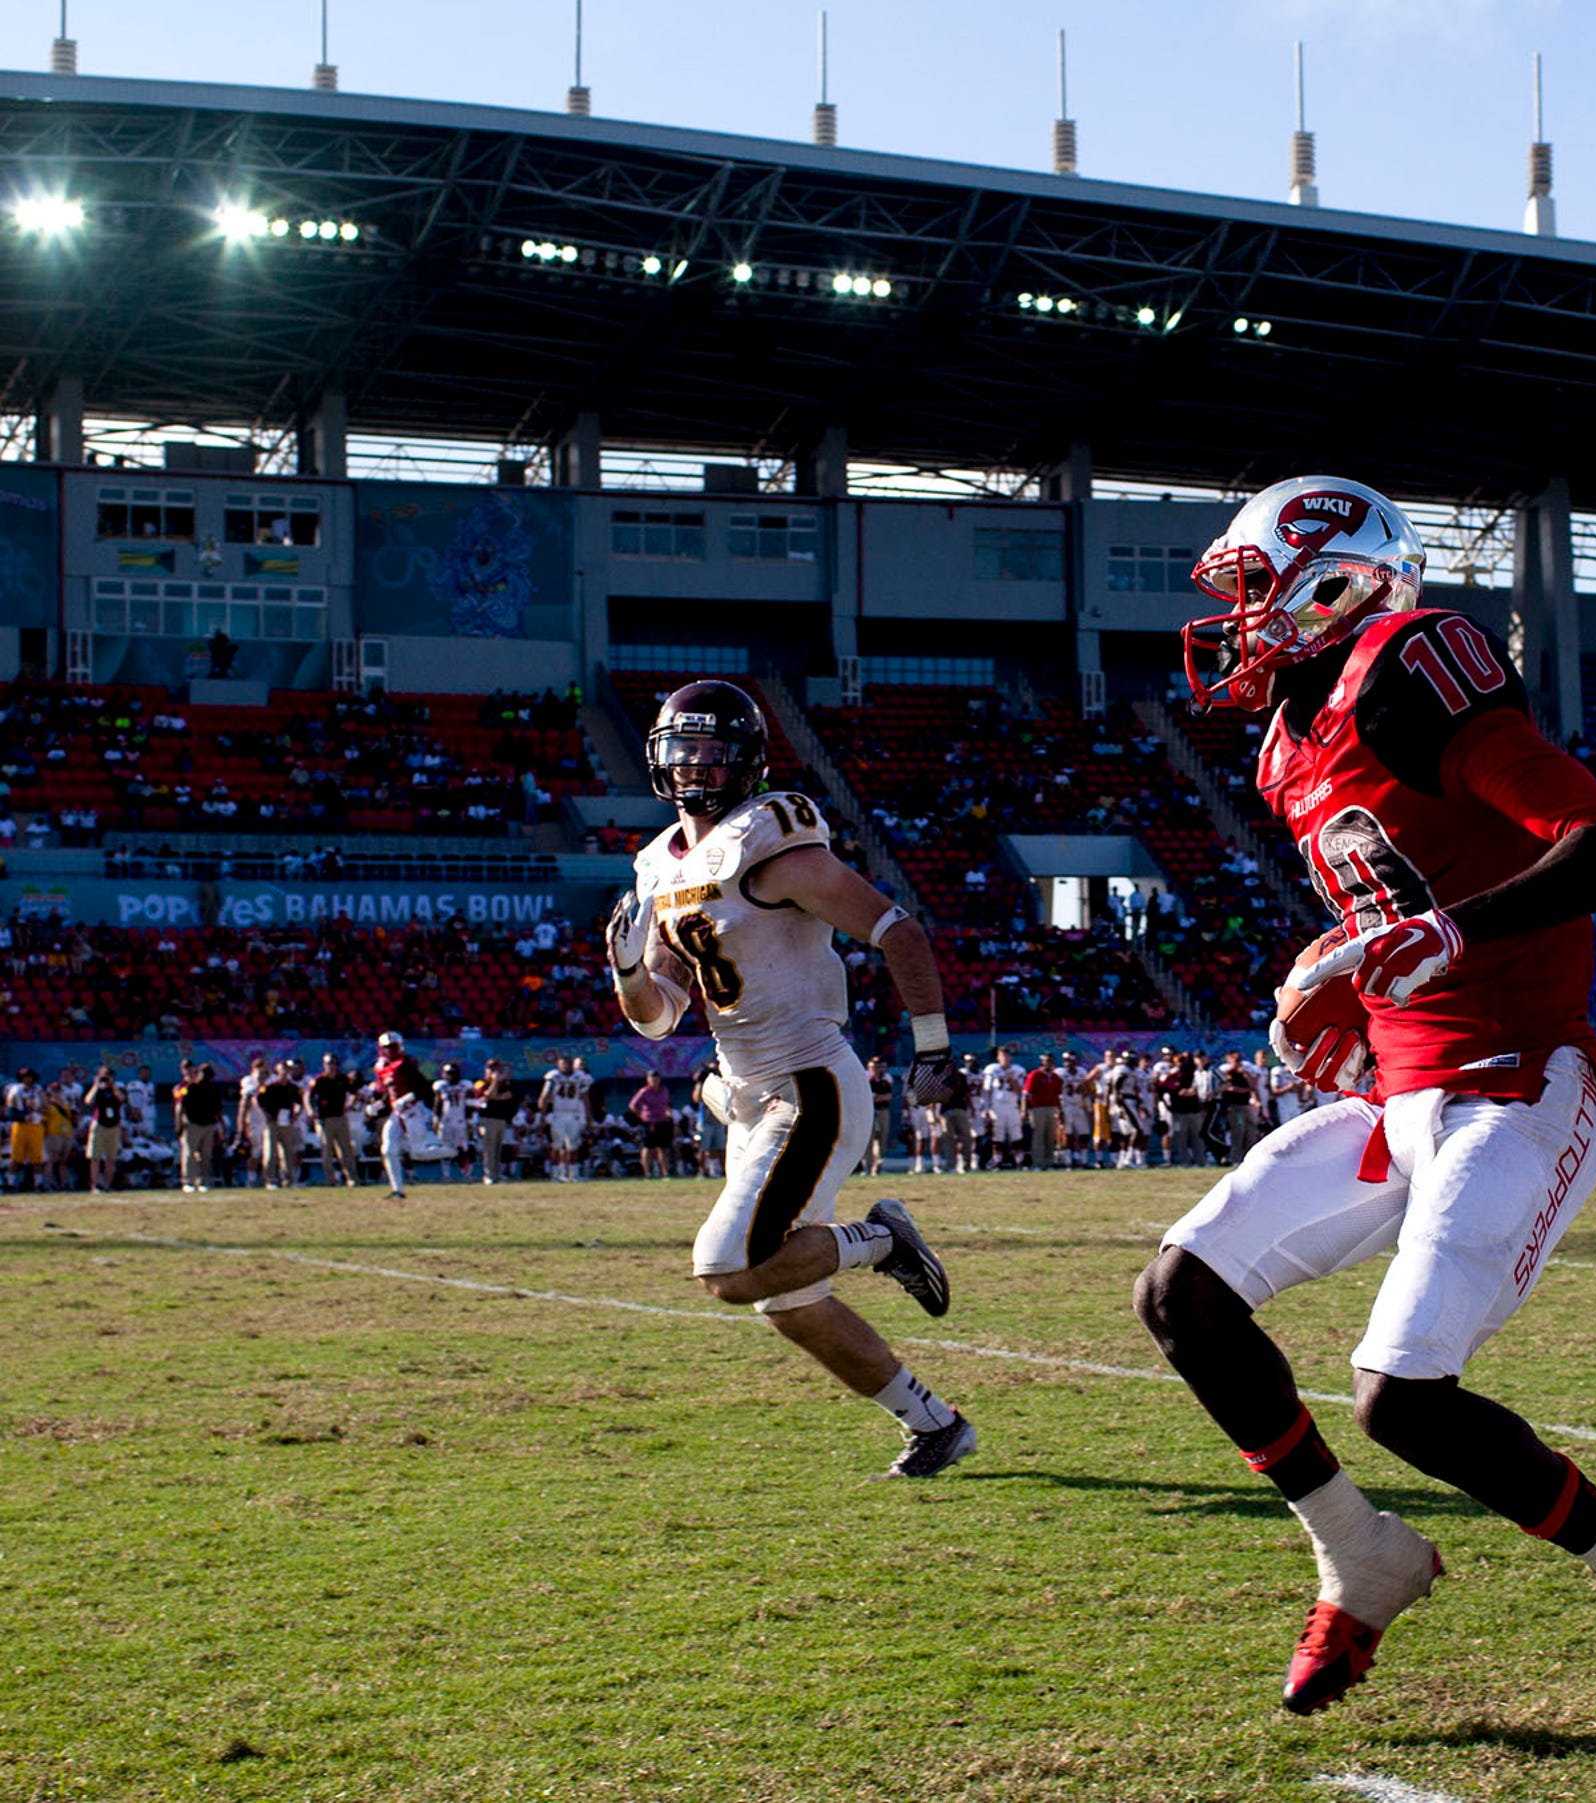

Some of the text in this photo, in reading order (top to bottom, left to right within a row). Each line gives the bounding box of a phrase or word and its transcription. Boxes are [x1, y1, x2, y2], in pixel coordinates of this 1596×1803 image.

[1302, 497, 1352, 517] WKU
[1399, 616, 1506, 716] 10
[757, 793, 819, 838] 18
[285, 894, 454, 922] BAHAMAS
